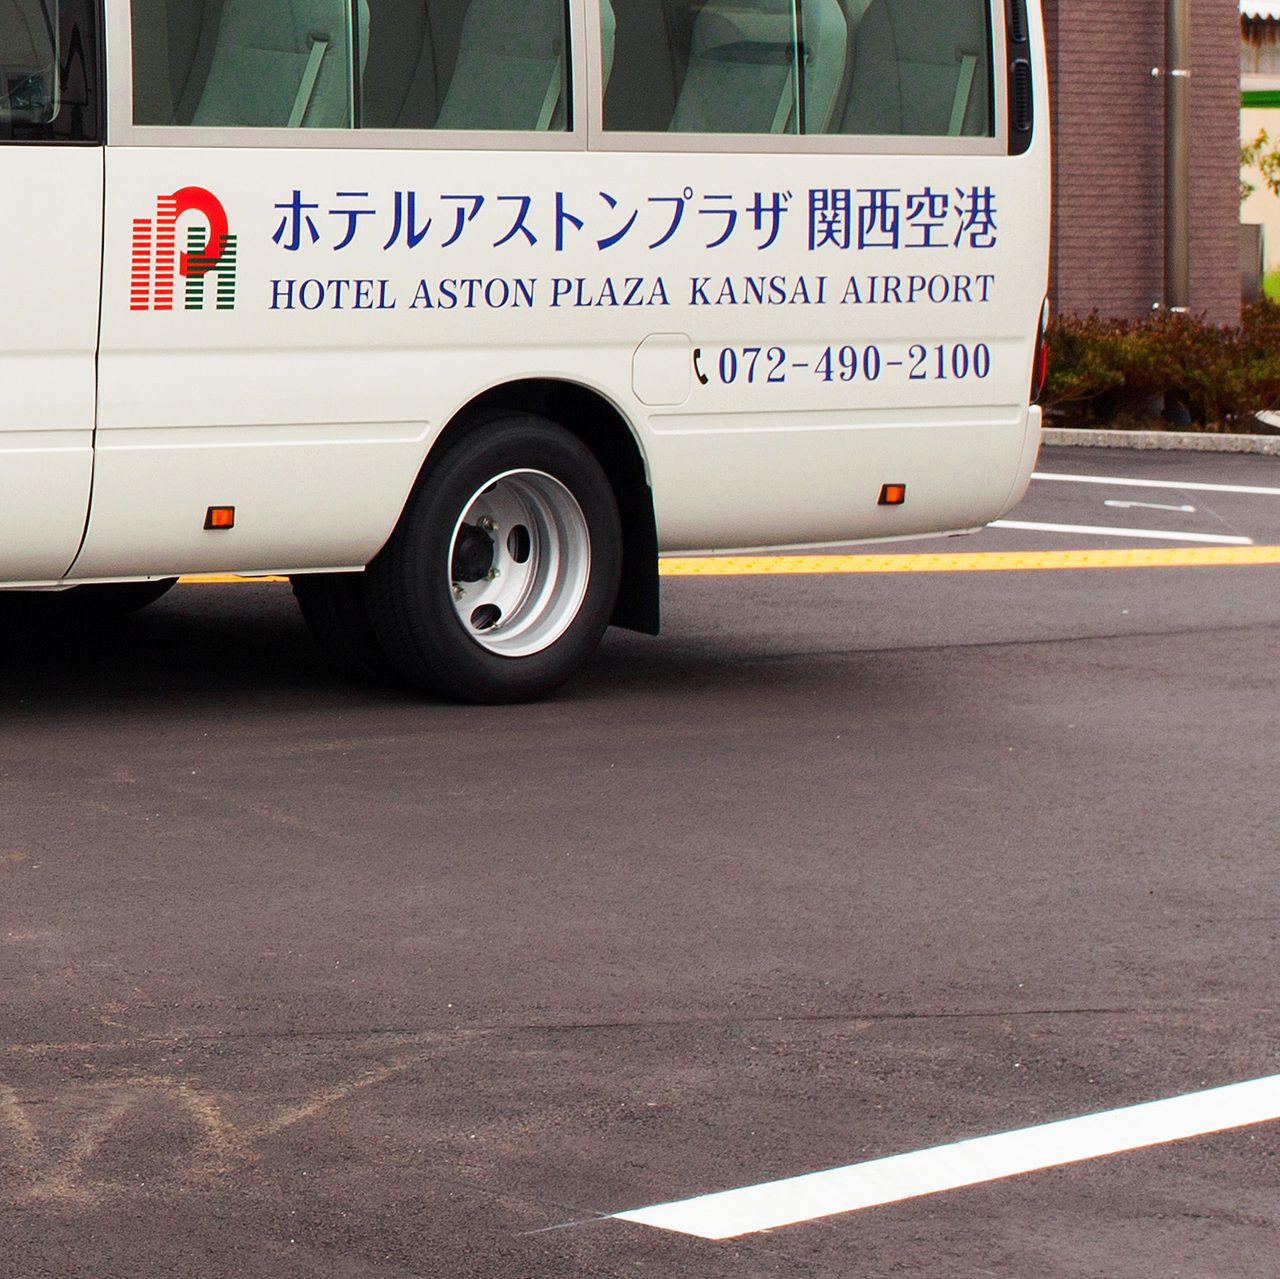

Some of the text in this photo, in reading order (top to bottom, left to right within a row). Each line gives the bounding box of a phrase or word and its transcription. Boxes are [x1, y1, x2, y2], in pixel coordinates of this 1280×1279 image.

[271, 185, 999, 252] ホテルアストンプラザ 関西空港
[267, 273, 996, 311] HOTEL ASTON PLAZA KANSAI AIRPORT
[718, 342, 992, 385] 072-490-2100
